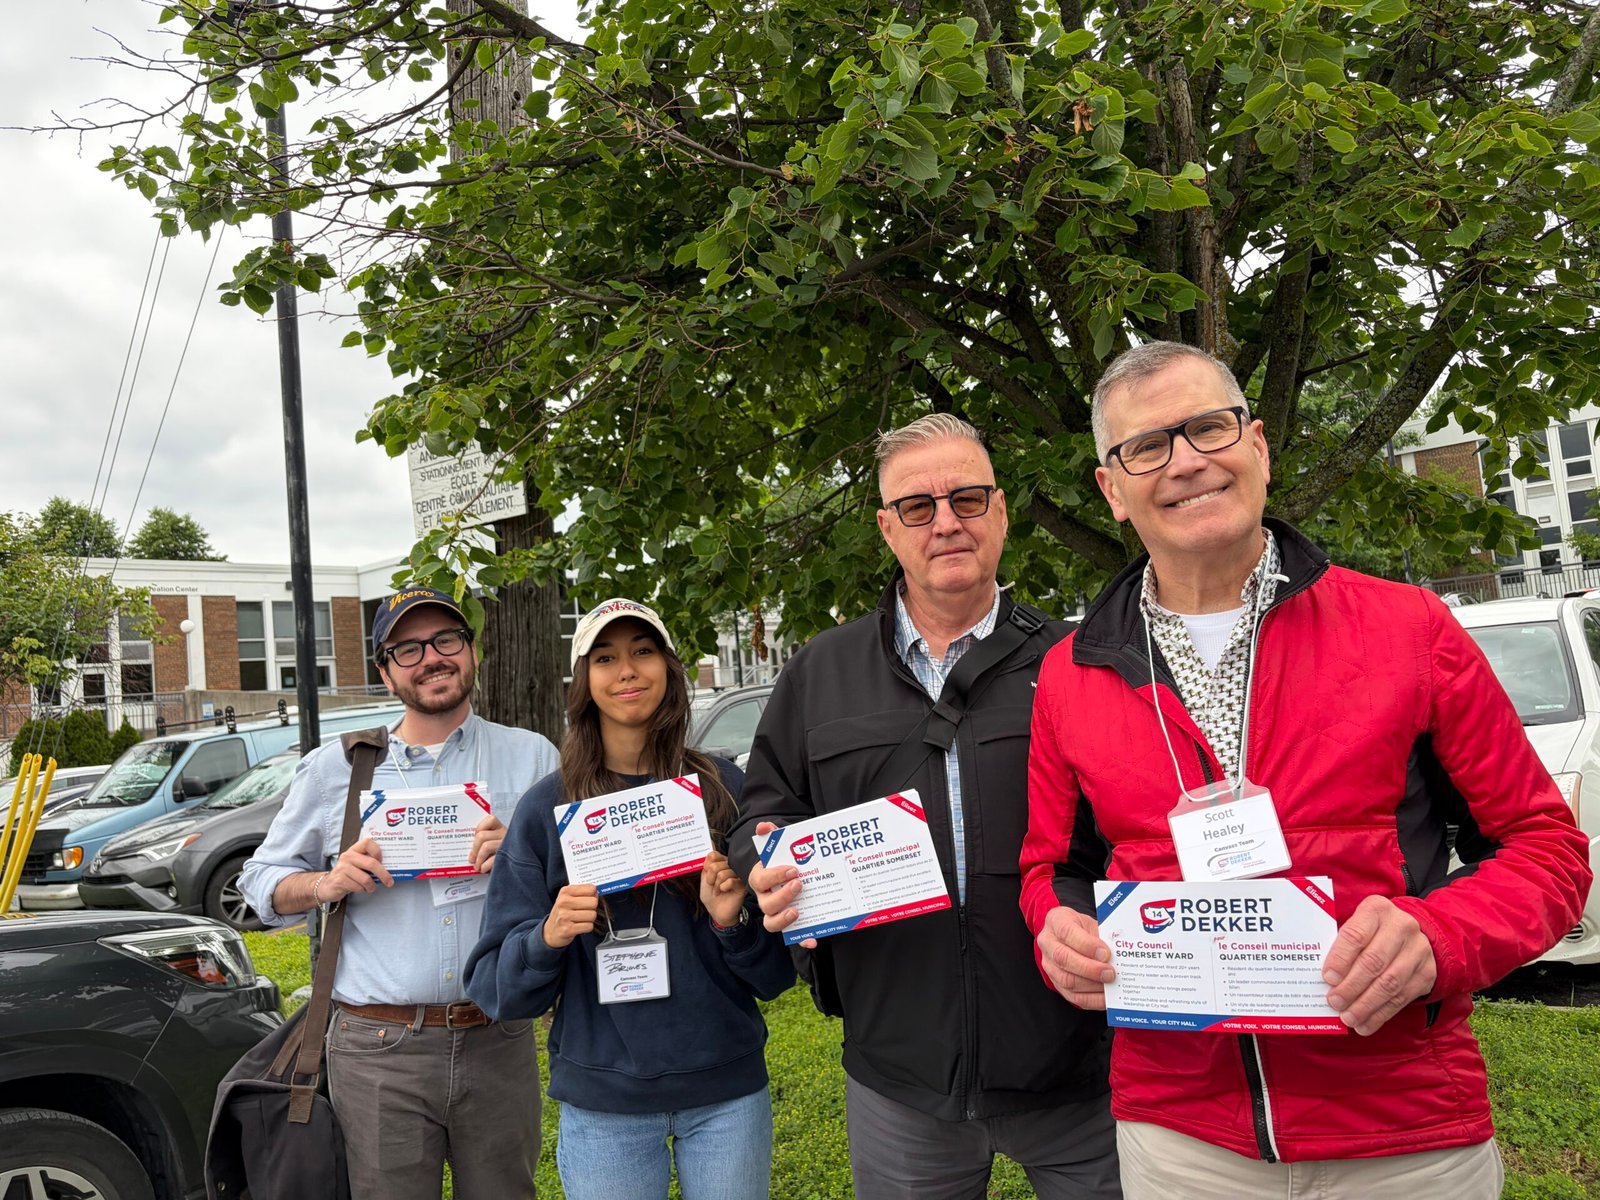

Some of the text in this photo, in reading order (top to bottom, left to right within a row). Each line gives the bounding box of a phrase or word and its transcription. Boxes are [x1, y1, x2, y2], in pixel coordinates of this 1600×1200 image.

[420, 457, 481, 482] STATIONNEMENT
[423, 515, 433, 529] ET
[408, 805, 458, 815] ROBERT
[609, 794, 663, 816] ROBERT
[408, 815, 457, 825] DEKKER
[611, 805, 665, 827] DEKKER
[642, 821, 664, 831] Conseil
[665, 813, 694, 825] municipal
[1205, 808, 1235, 823] Scott
[636, 820, 695, 839] QUARTIER SOMERSET
[816, 817, 880, 844] ROBERT
[1203, 824, 1245, 840] Healey
[570, 836, 608, 850] City Council
[572, 839, 621, 855] SOMERSET WARD
[799, 845, 807, 853] 14
[820, 831, 884, 857] DEKKER
[1238, 839, 1254, 847] Team
[857, 851, 883, 863] Conseil
[884, 842, 920, 856] municipal
[851, 850, 921, 873] QUARTIER SOMERSET
[814, 872, 835, 881] WARD
[1108, 891, 1123, 906] Elect
[1306, 885, 1326, 904] Élisez
[1180, 898, 1272, 914] ROBERT
[1182, 916, 1273, 932] DEKKER
[1115, 940, 1172, 949] City Council
[1230, 942, 1267, 950] Conseil
[1270, 942, 1320, 951] municipal
[1115, 950, 1161, 958] SOMERSET
[1270, 953, 1321, 961] SOMERSET
